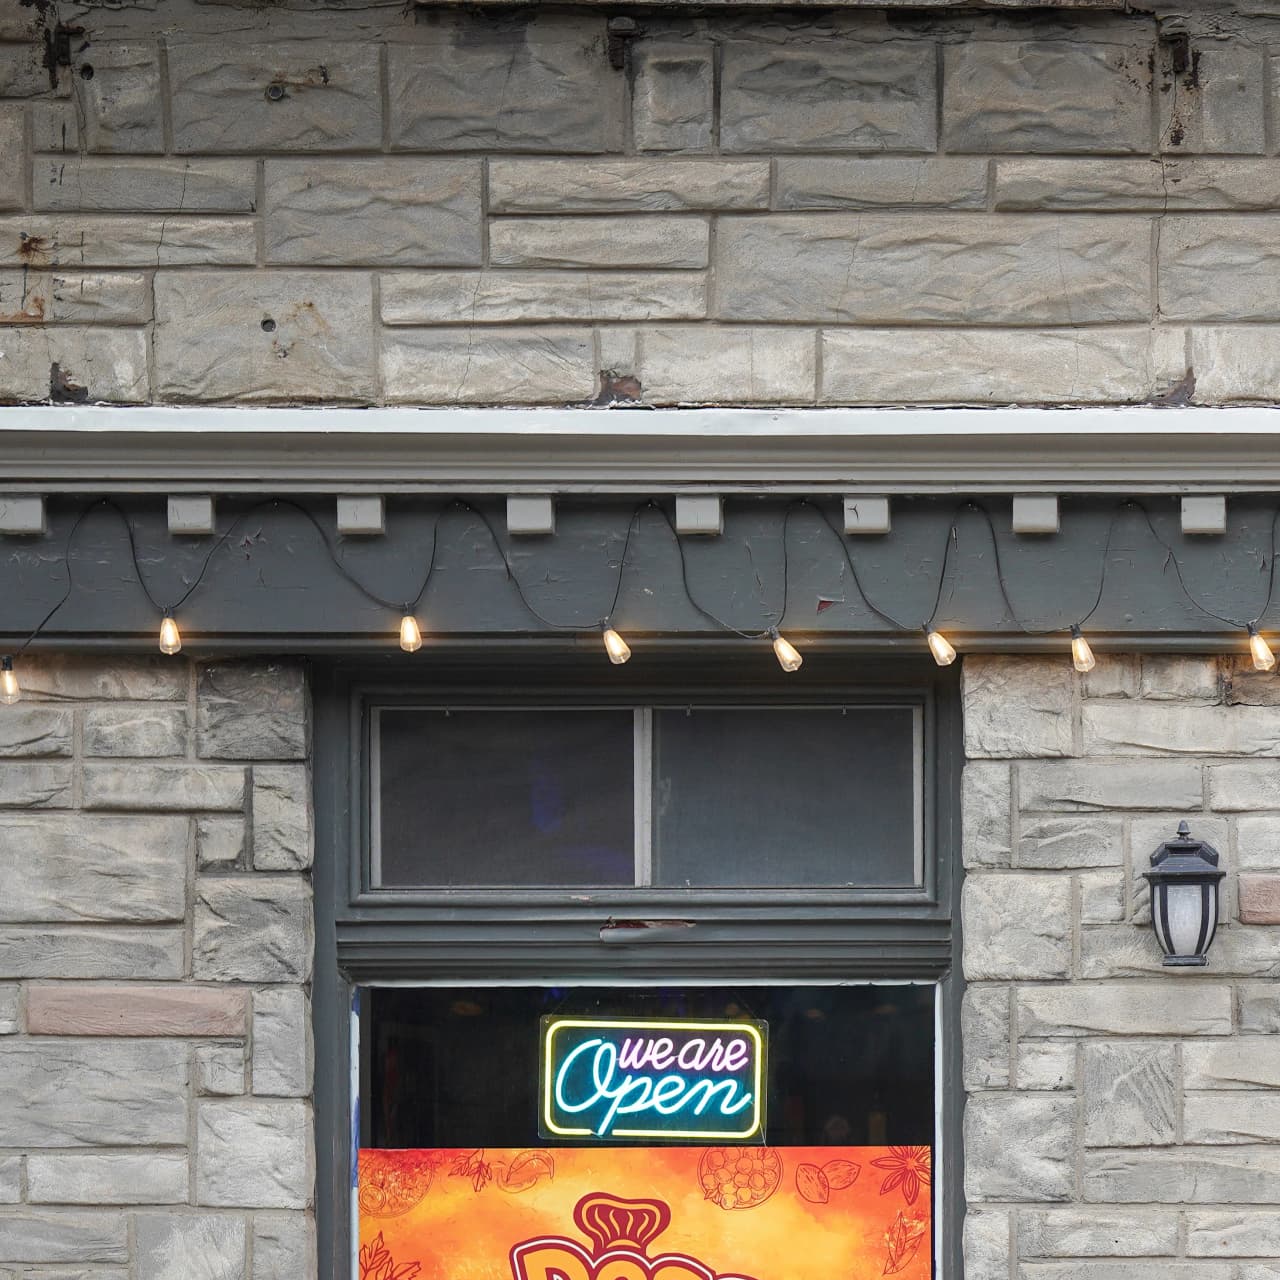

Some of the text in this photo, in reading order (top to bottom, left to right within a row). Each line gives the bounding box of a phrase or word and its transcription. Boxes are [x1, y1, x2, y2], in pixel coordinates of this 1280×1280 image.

[555, 1038, 753, 1136] Open
[618, 1037, 749, 1072] we are
